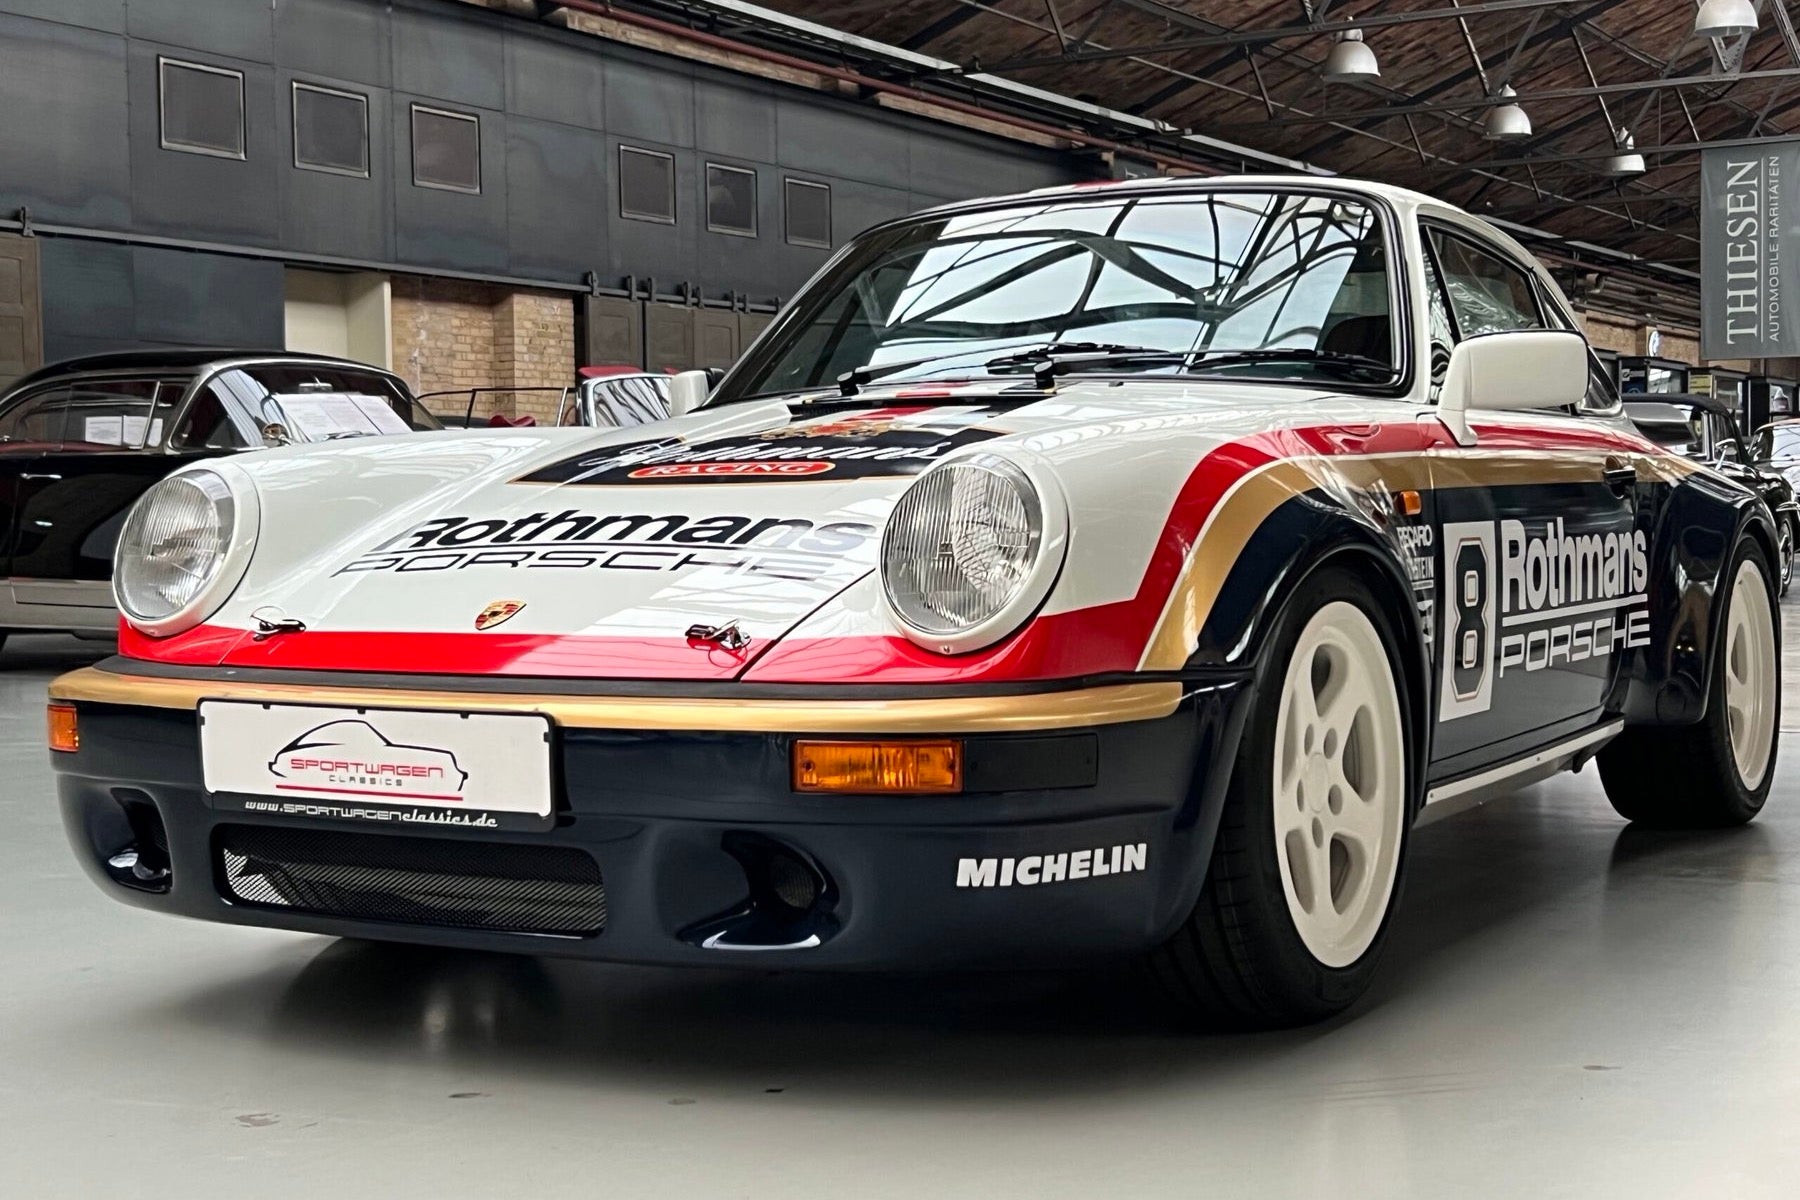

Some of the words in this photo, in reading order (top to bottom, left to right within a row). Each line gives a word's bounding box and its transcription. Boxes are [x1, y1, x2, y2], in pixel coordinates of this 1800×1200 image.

[1768, 156, 1780, 239] RARITÄTEN
[1727, 160, 1758, 345] THIESEN
[1768, 243, 1780, 342] AUTOMOBILE
[649, 463, 814, 475] RACING
[370, 509, 877, 552] Rothmans
[1396, 524, 1433, 547] RECARO
[329, 550, 834, 581] PORSCHE
[1501, 516, 1648, 612] Rothmans
[1451, 537, 1490, 703] 8
[1499, 610, 1651, 678] PORSCHE
[290, 759, 443, 778] SPORTWAGEN
[329, 774, 403, 787] CLASSICS
[956, 843, 1147, 887] MICHELIN
